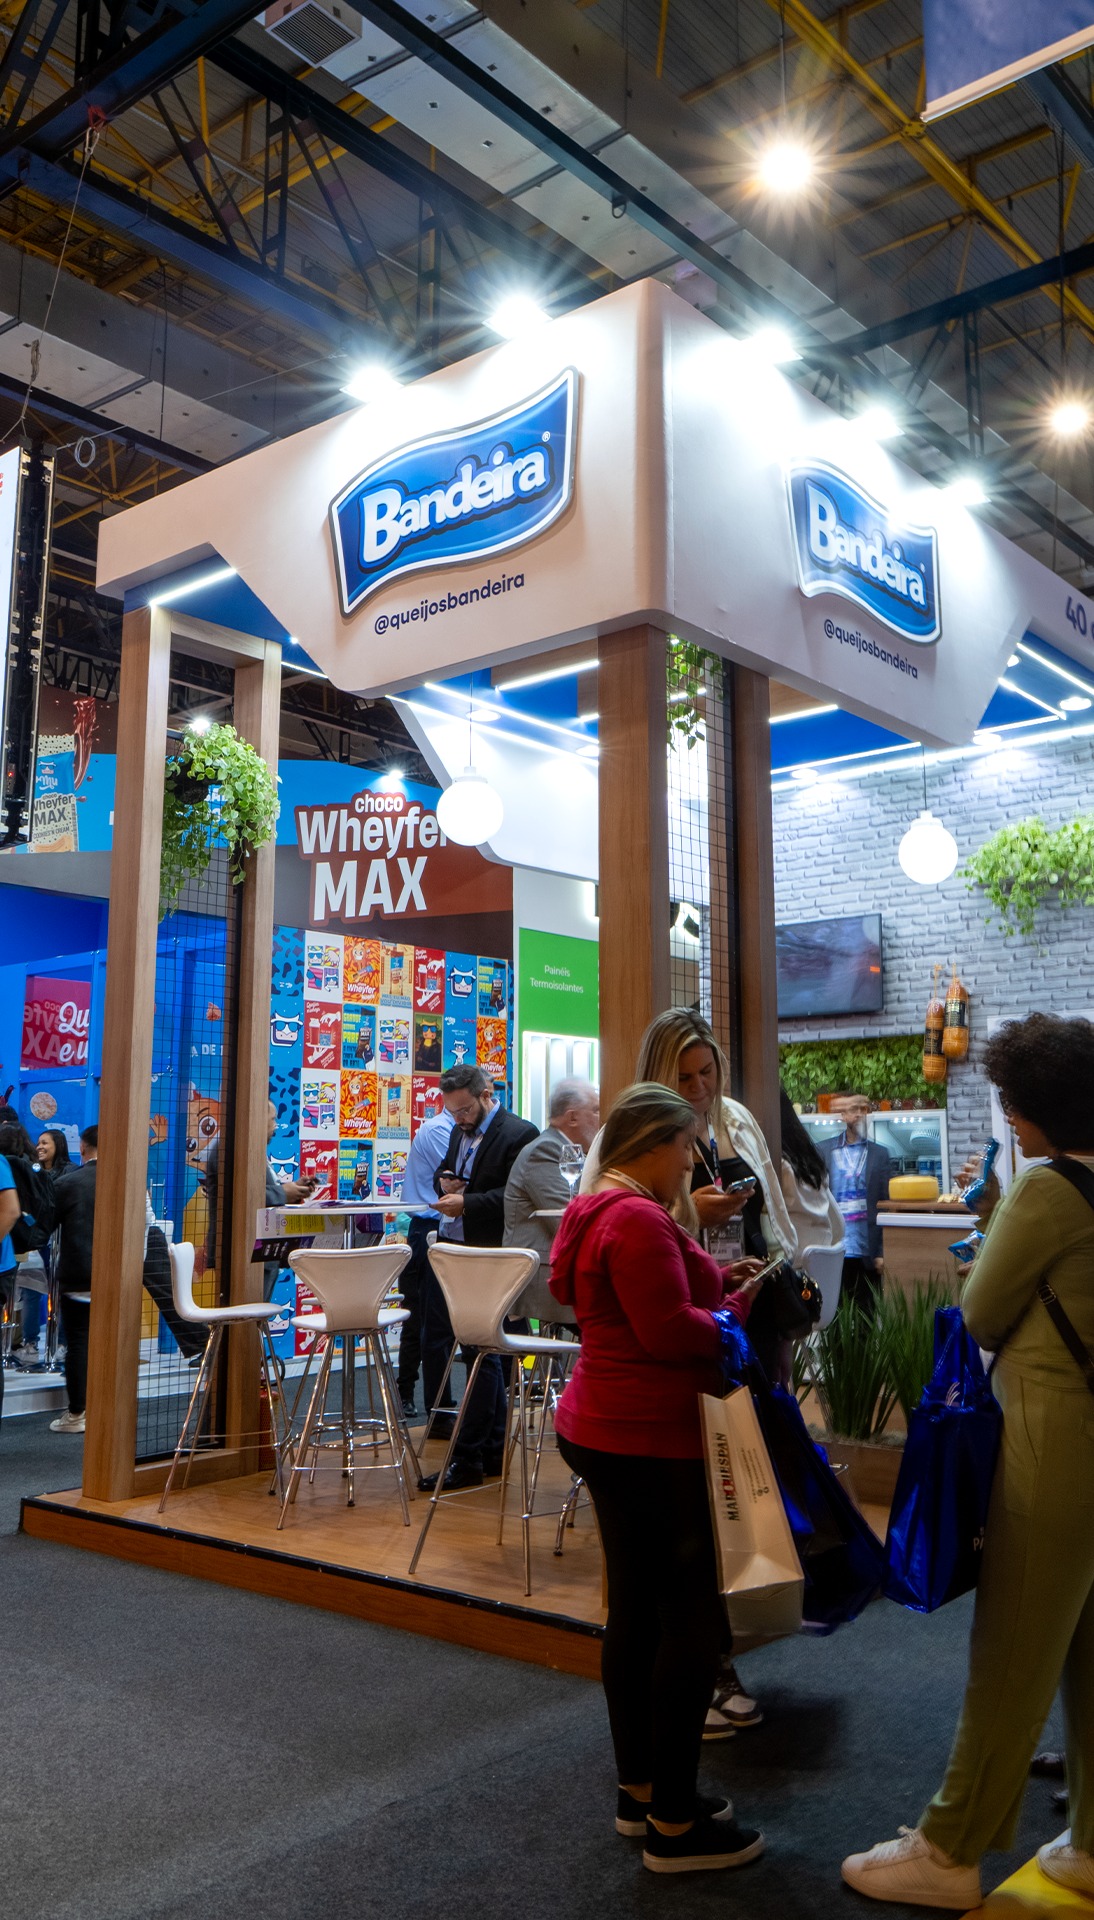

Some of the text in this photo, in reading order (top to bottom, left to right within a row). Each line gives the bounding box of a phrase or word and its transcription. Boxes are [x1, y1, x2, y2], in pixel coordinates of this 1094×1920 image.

[362, 450, 546, 563] Bandeira
[807, 484, 926, 606] Bandeira
[374, 573, 525, 635] @queijosbandeira
[1066, 596, 1087, 636] 40
[824, 619, 918, 679] @queijosbandeira
[34, 807, 67, 828] MAX
[355, 793, 404, 813] choco
[314, 856, 428, 921] MAX
[530, 977, 584, 993] Termoisolantes
[544, 965, 570, 977] Painéis
[201, 1044, 216, 1056] DE
